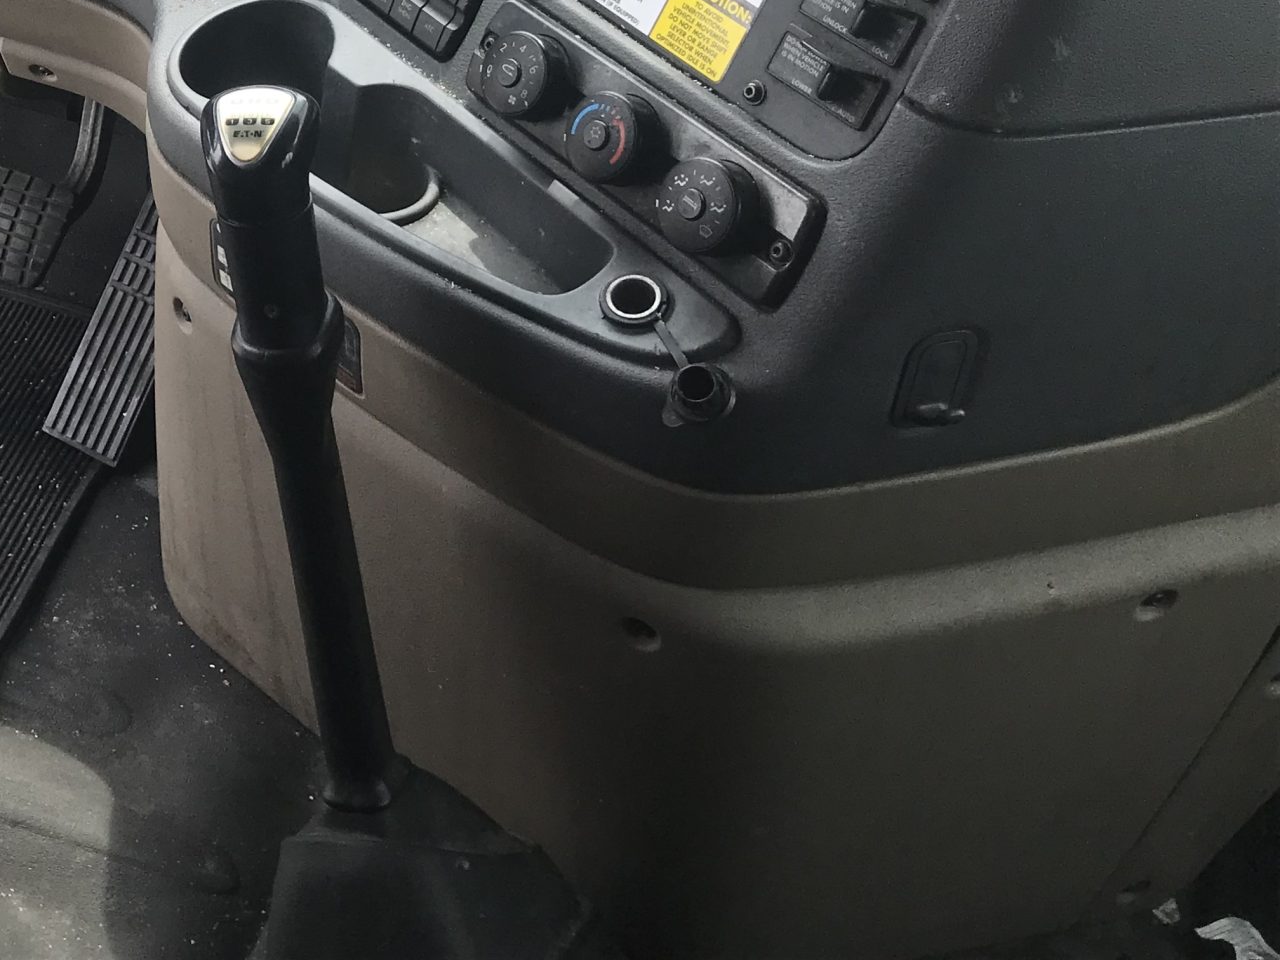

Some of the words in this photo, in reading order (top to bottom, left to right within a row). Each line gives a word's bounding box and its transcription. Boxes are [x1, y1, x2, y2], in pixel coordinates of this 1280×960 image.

[673, 7, 695, 24] VEHICLE
[682, 3, 730, 37] UNINTENTIONAL
[695, 1, 704, 11] TO
[704, 7, 724, 23] AVOID
[822, 15, 848, 34] UNLOCK
[668, 13, 679, 23] DO
[678, 20, 693, 32] NOT
[692, 29, 711, 44] MOVE
[711, 41, 727, 55] SHIFT
[669, 23, 687, 38] LEVER
[686, 35, 697, 44] OR
[697, 42, 718, 58] RANGE
[500, 42, 508, 53] 2
[520, 45, 527, 53] 4
[656, 33, 687, 57] OPTIMIZED
[687, 54, 699, 66] IDLE
[706, 67, 717, 78] ON
[667, 31, 694, 52] SELECTOR
[694, 49, 713, 65] WHEN
[871, 45, 891, 60] LOCK
[529, 65, 539, 74] 6
[794, 58, 820, 77] MOTION
[801, 54, 825, 72] VEHICLE
[520, 89, 528, 99] 8
[791, 77, 813, 95] LOWER
[837, 108, 856, 124] AUTO
